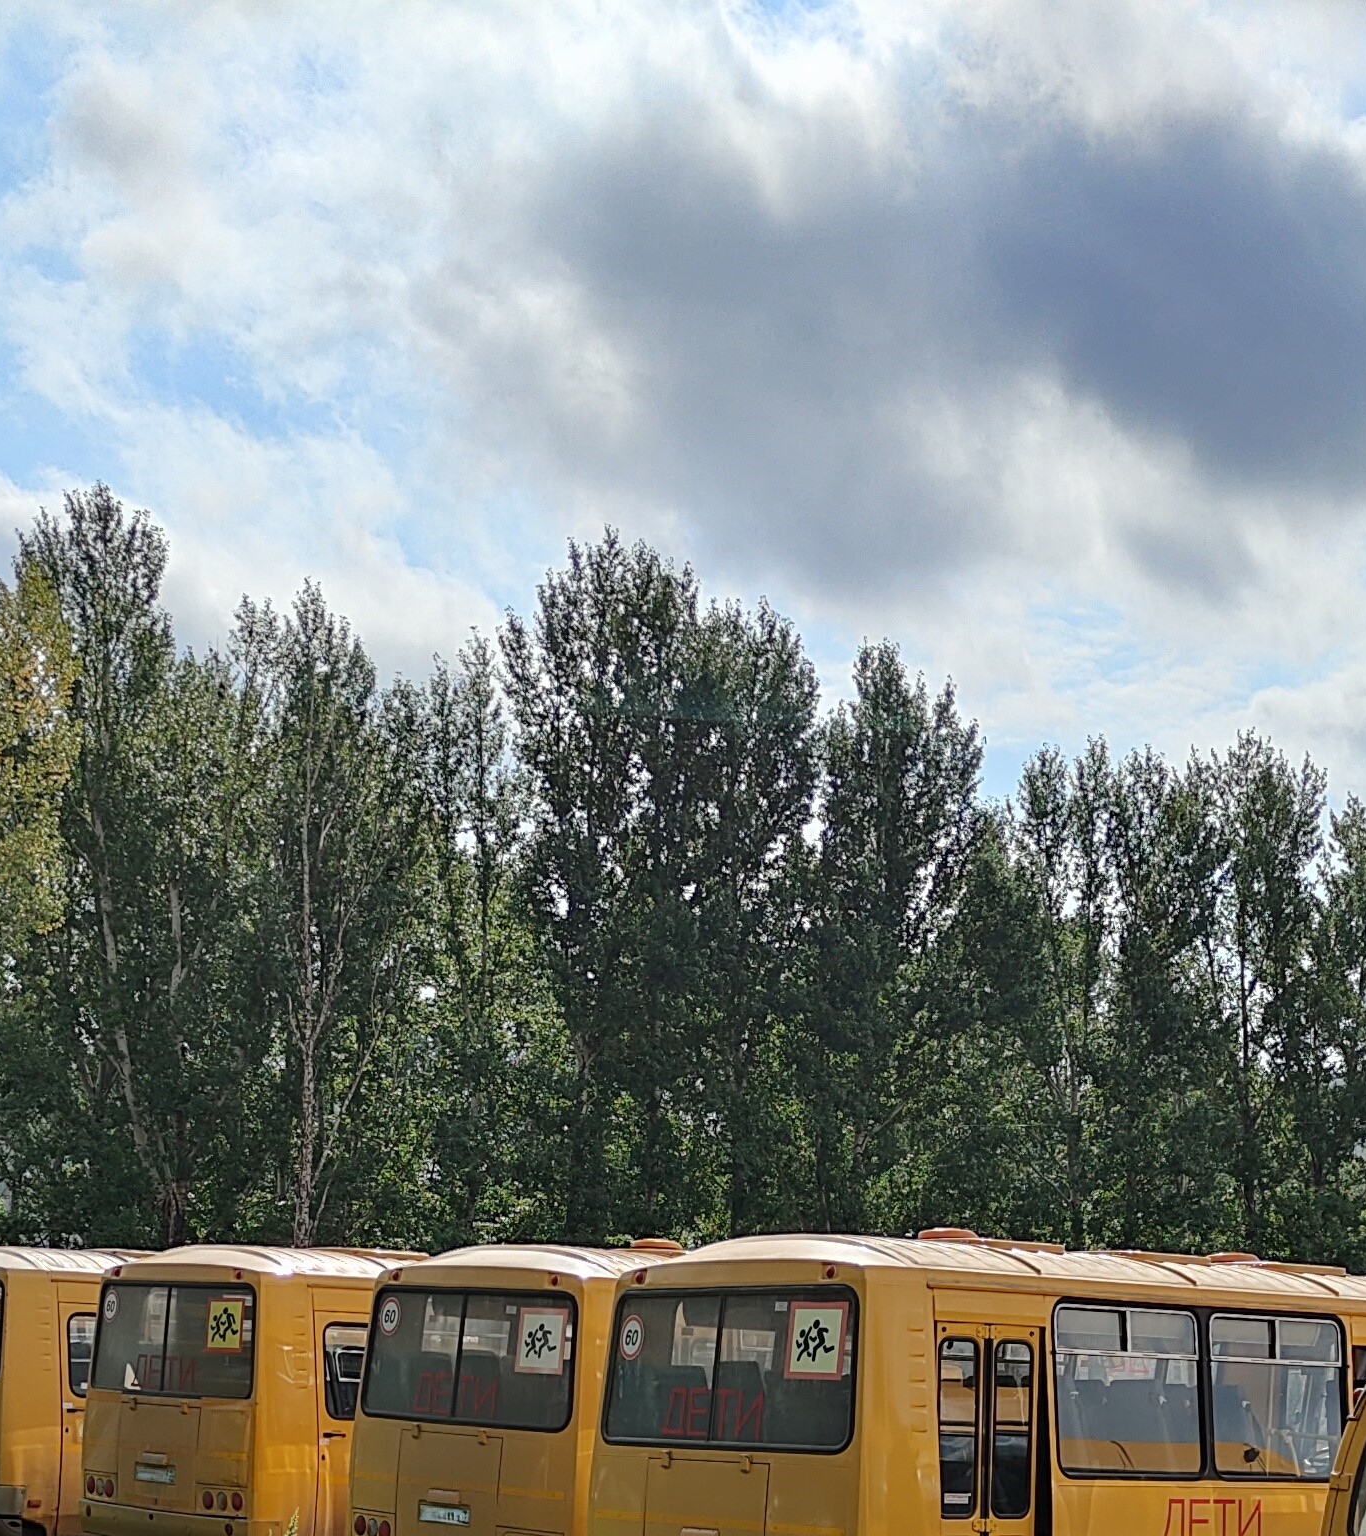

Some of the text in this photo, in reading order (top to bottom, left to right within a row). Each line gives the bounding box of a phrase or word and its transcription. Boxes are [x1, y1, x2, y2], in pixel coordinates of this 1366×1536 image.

[106, 1300, 115, 1313] 60
[384, 1309, 396, 1323] 60
[625, 1329, 639, 1346] 60
[131, 1354, 196, 1391] ДЕТИ
[412, 1372, 498, 1419] ДЕТИ
[660, 1387, 765, 1441] ДЕТИ
